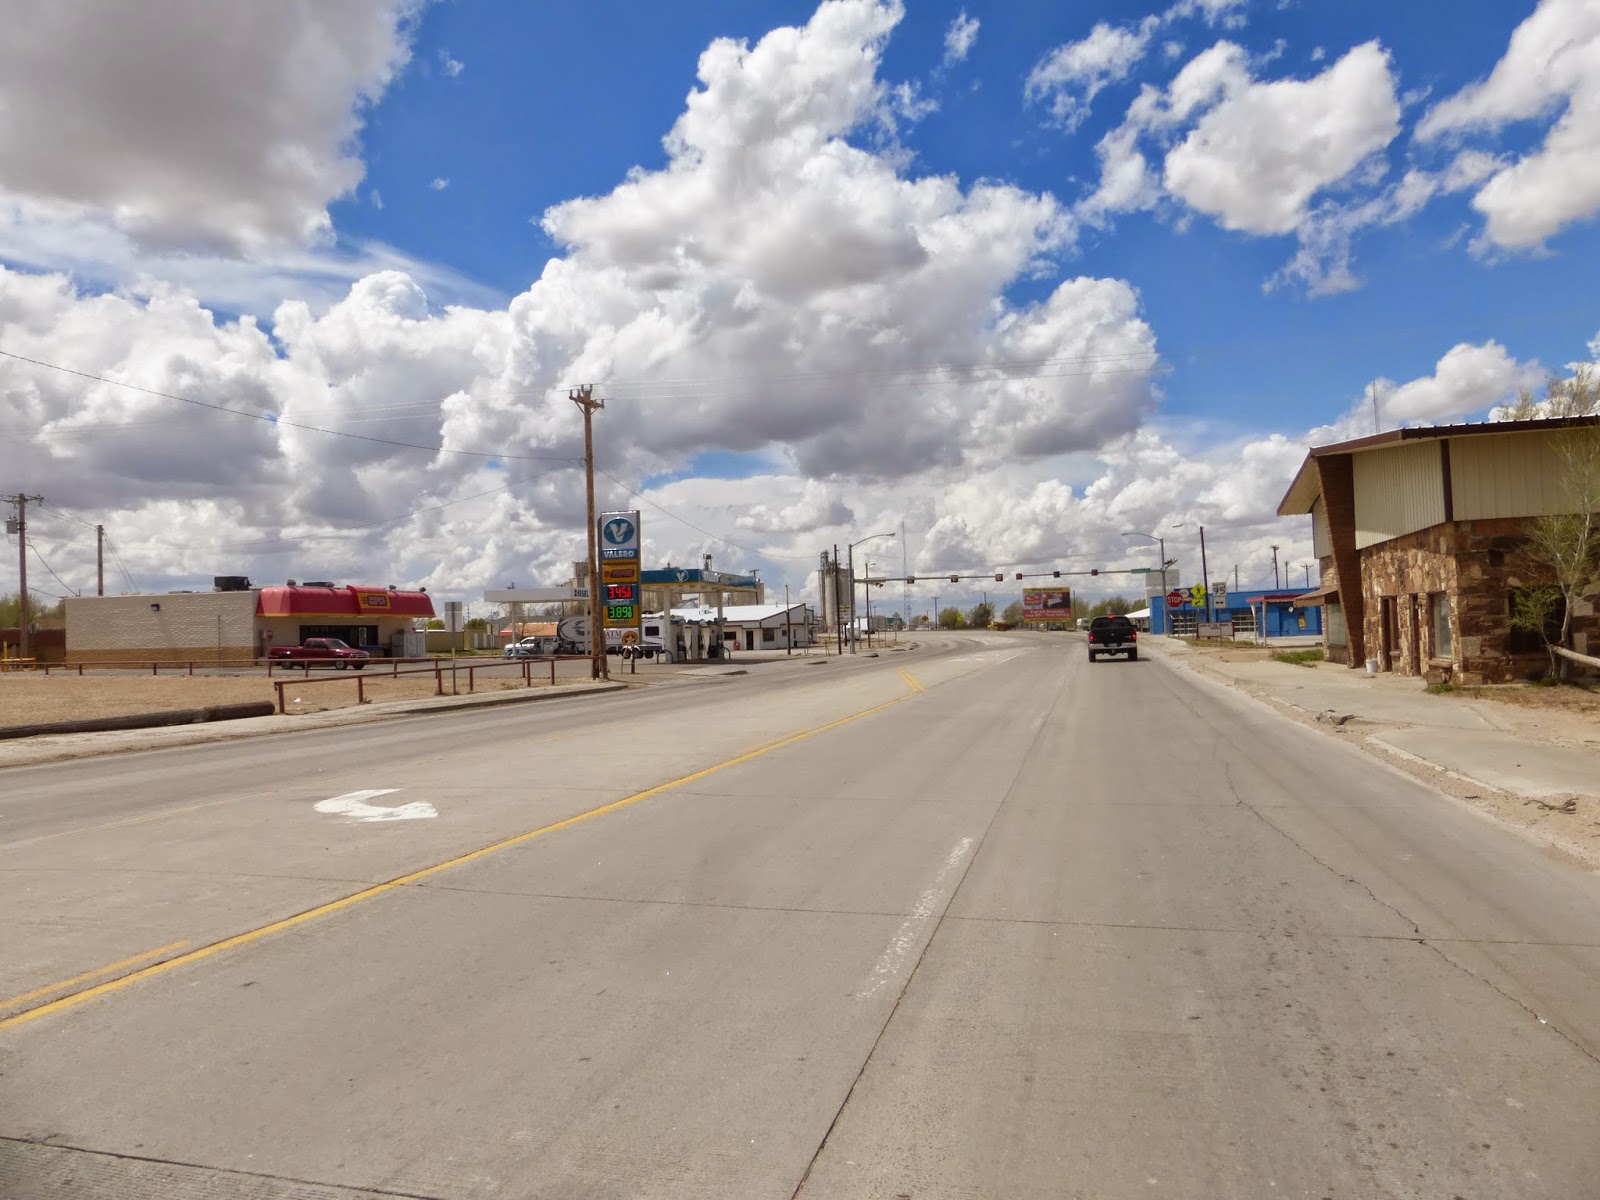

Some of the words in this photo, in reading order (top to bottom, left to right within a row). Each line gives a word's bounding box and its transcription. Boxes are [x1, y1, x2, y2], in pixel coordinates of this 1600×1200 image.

[603, 550, 634, 558] VALERO
[574, 588, 589, 598] DIESEL
[606, 630, 622, 638] ATM
